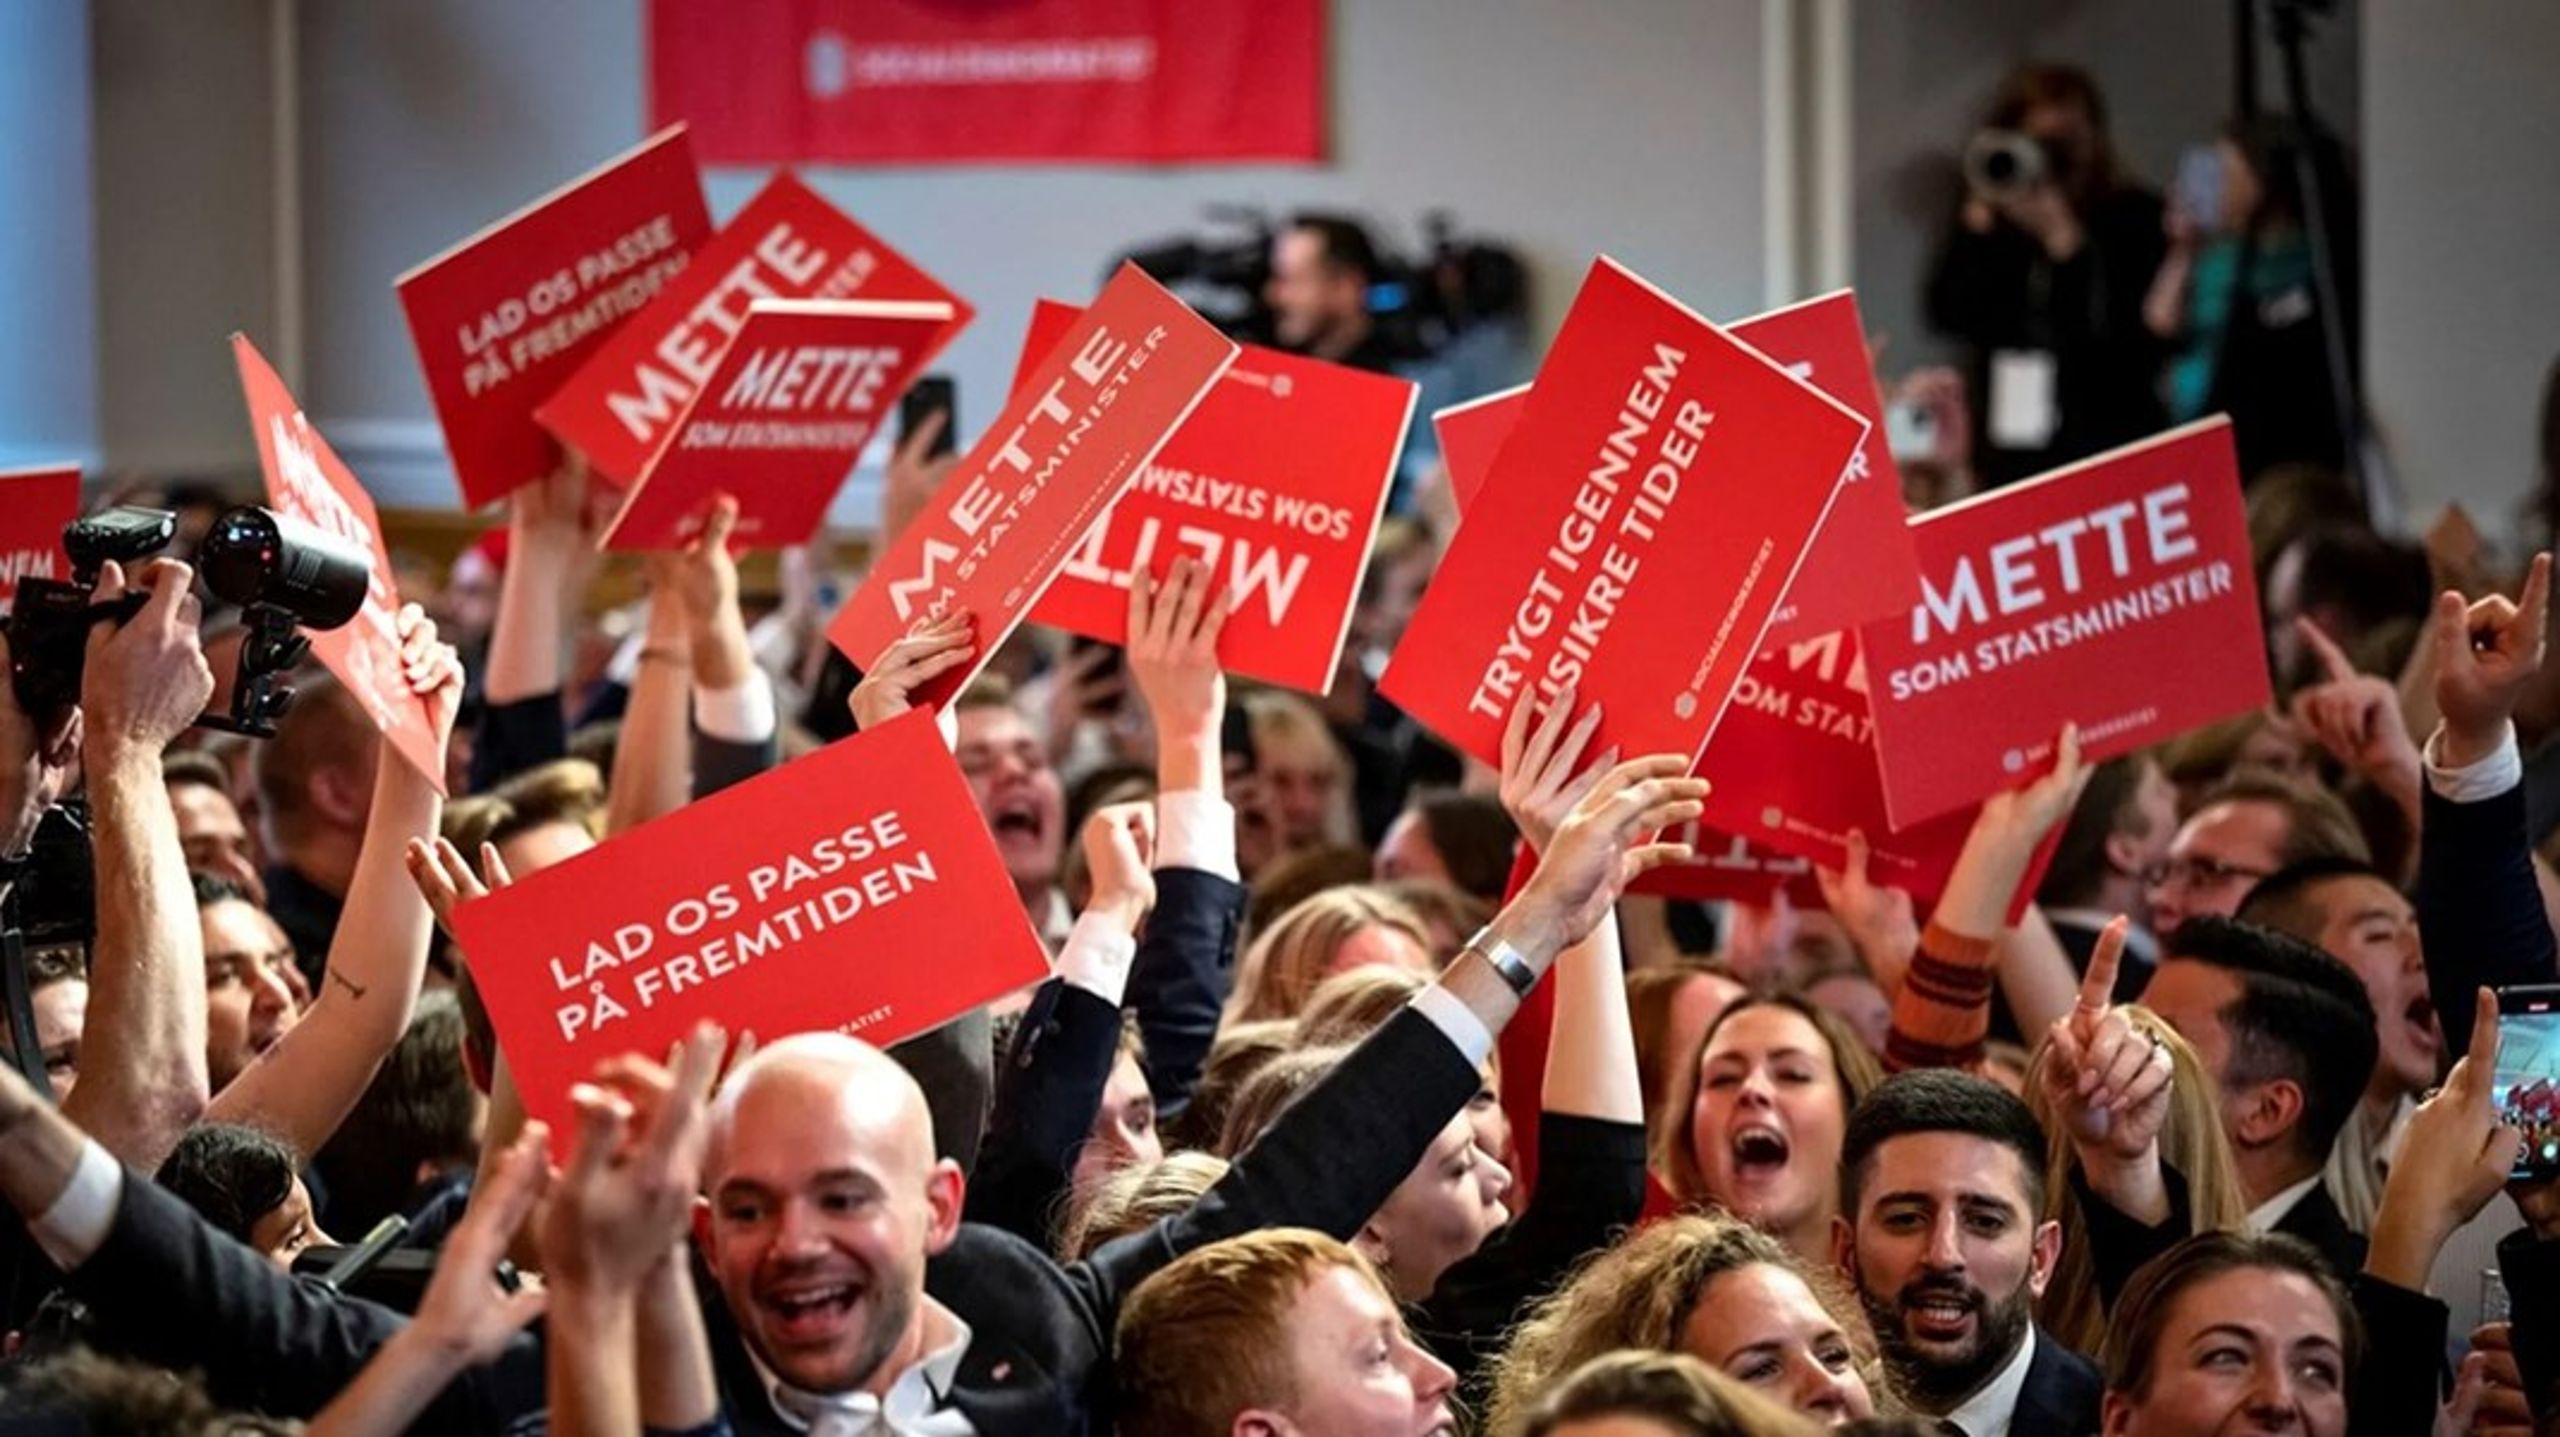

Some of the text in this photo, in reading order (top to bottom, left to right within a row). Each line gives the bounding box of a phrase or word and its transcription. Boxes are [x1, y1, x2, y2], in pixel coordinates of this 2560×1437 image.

[458, 212, 680, 356] LAD OS PASSE
[606, 222, 828, 442] METTE
[463, 344, 512, 398] PÅ
[720, 346, 901, 410] METTE
[889, 325, 1128, 622] METTE
[957, 325, 1169, 580] STATSMINISTER
[1272, 494, 1353, 541] SOM
[1620, 399, 1715, 541] TIDER
[1064, 506, 1310, 627] METT
[1470, 342, 1688, 719] TRYGT IGENNEM
[1911, 482, 2199, 646] METTE
[1731, 674, 1791, 719] OM
[1889, 651, 1971, 701] SOM
[1975, 560, 2233, 672] STATSMINISTER
[549, 811, 907, 991] LAD OS PASSE
[556, 850, 938, 1042] PÅ FREMTIDEN
